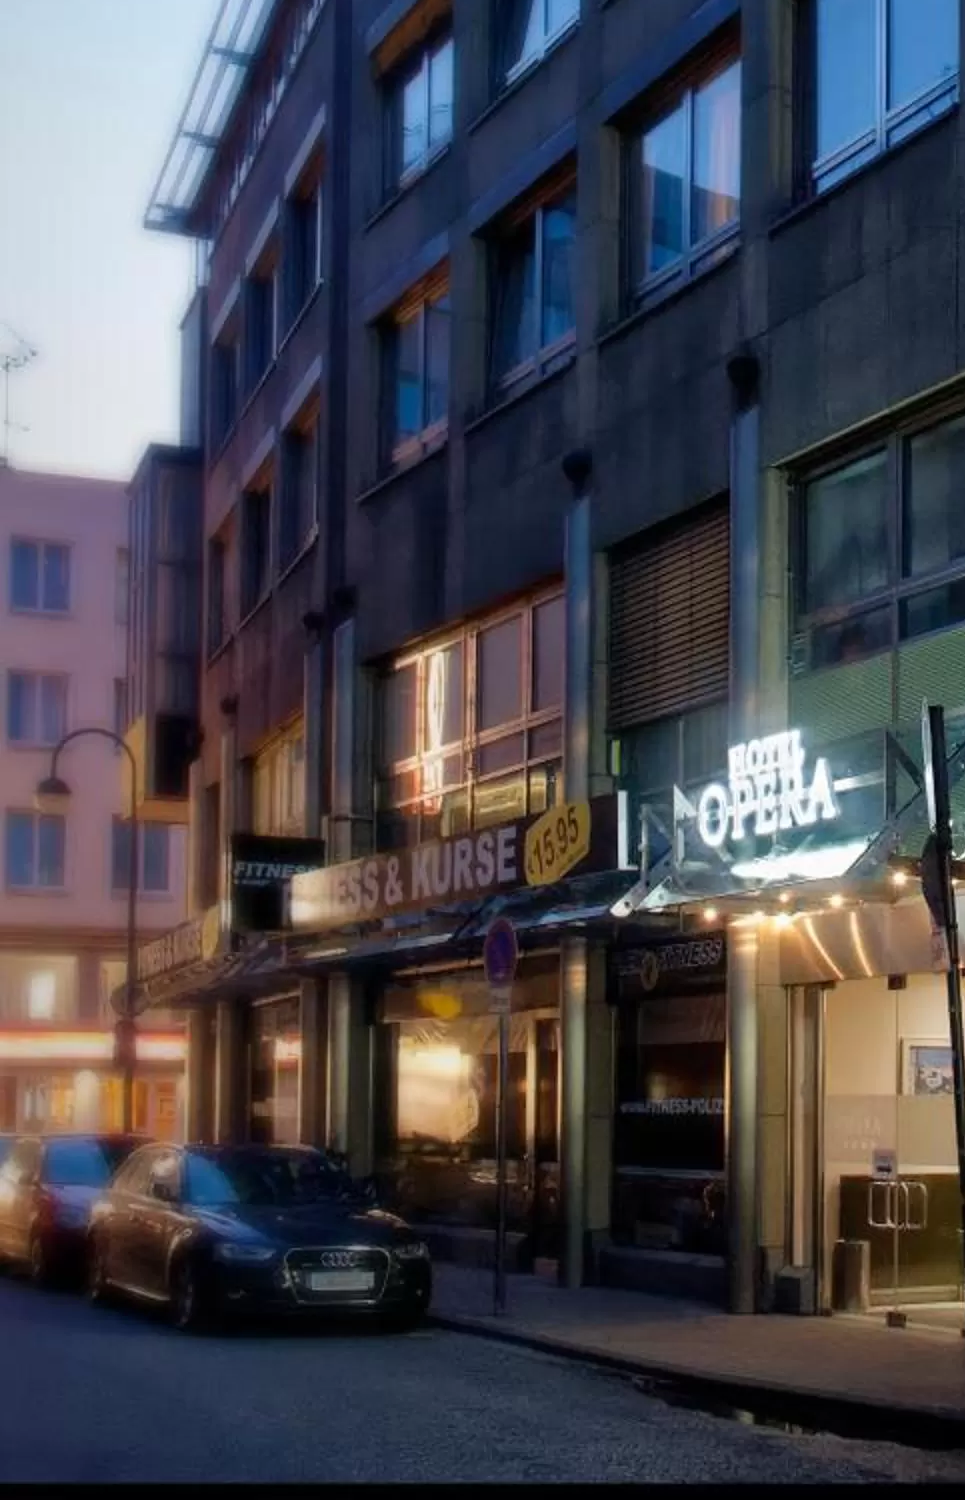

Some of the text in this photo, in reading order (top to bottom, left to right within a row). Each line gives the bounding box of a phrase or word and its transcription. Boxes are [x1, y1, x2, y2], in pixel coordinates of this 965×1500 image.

[727, 728, 805, 779] HOTEL
[698, 757, 838, 847] OPERA
[384, 855, 403, 906] &
[411, 827, 517, 899] KURSE
